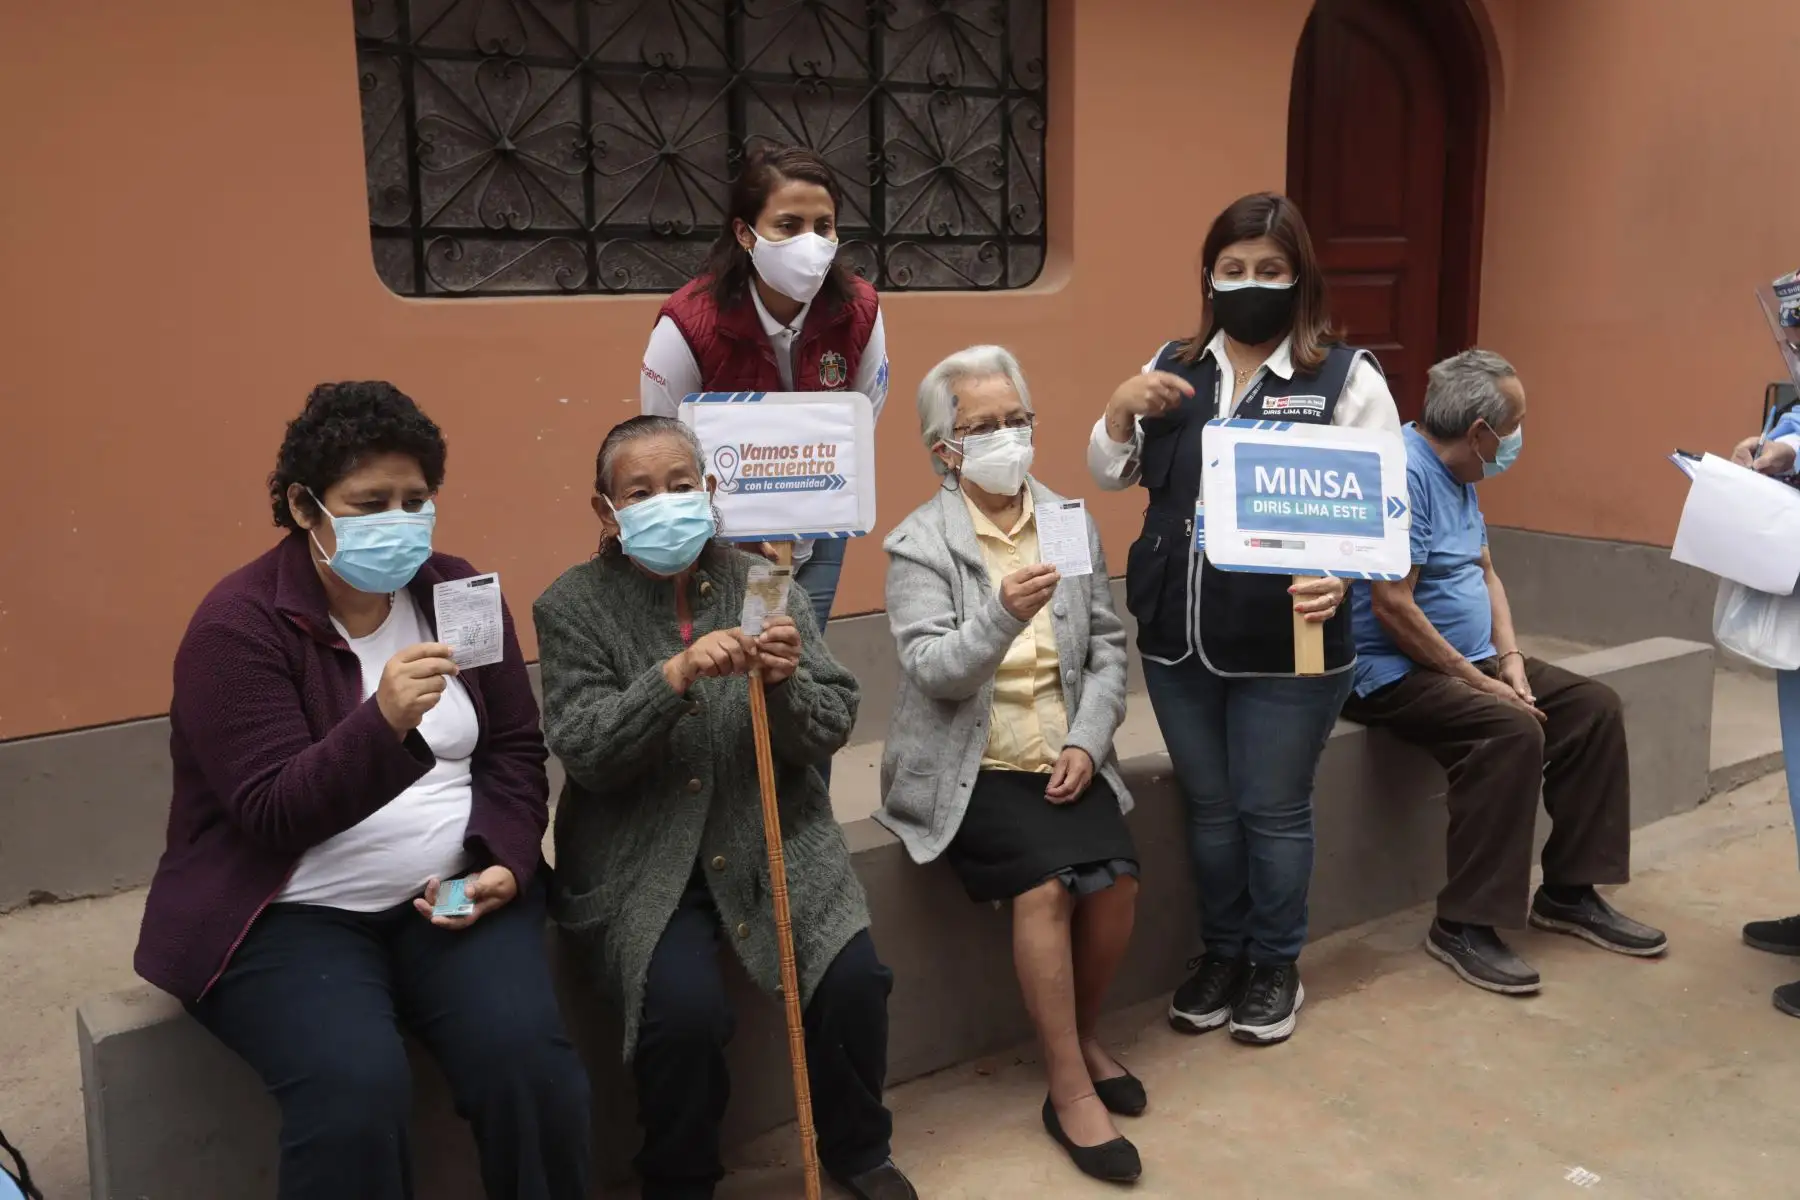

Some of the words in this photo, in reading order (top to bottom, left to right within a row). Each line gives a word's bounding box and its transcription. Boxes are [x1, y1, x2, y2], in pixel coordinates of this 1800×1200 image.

[1302, 408, 1321, 417] ESTE
[740, 443, 798, 460] Vamos
[803, 445, 814, 459] a
[817, 443, 836, 458] tu
[741, 459, 835, 477] encuentro
[744, 482, 762, 491] con
[763, 480, 772, 490] la
[775, 478, 826, 489] comunidad
[1254, 465, 1364, 500] MINSA
[1253, 500, 1292, 515] DIRIS
[1295, 502, 1330, 517] LIMA
[1332, 504, 1368, 520] ESTE
